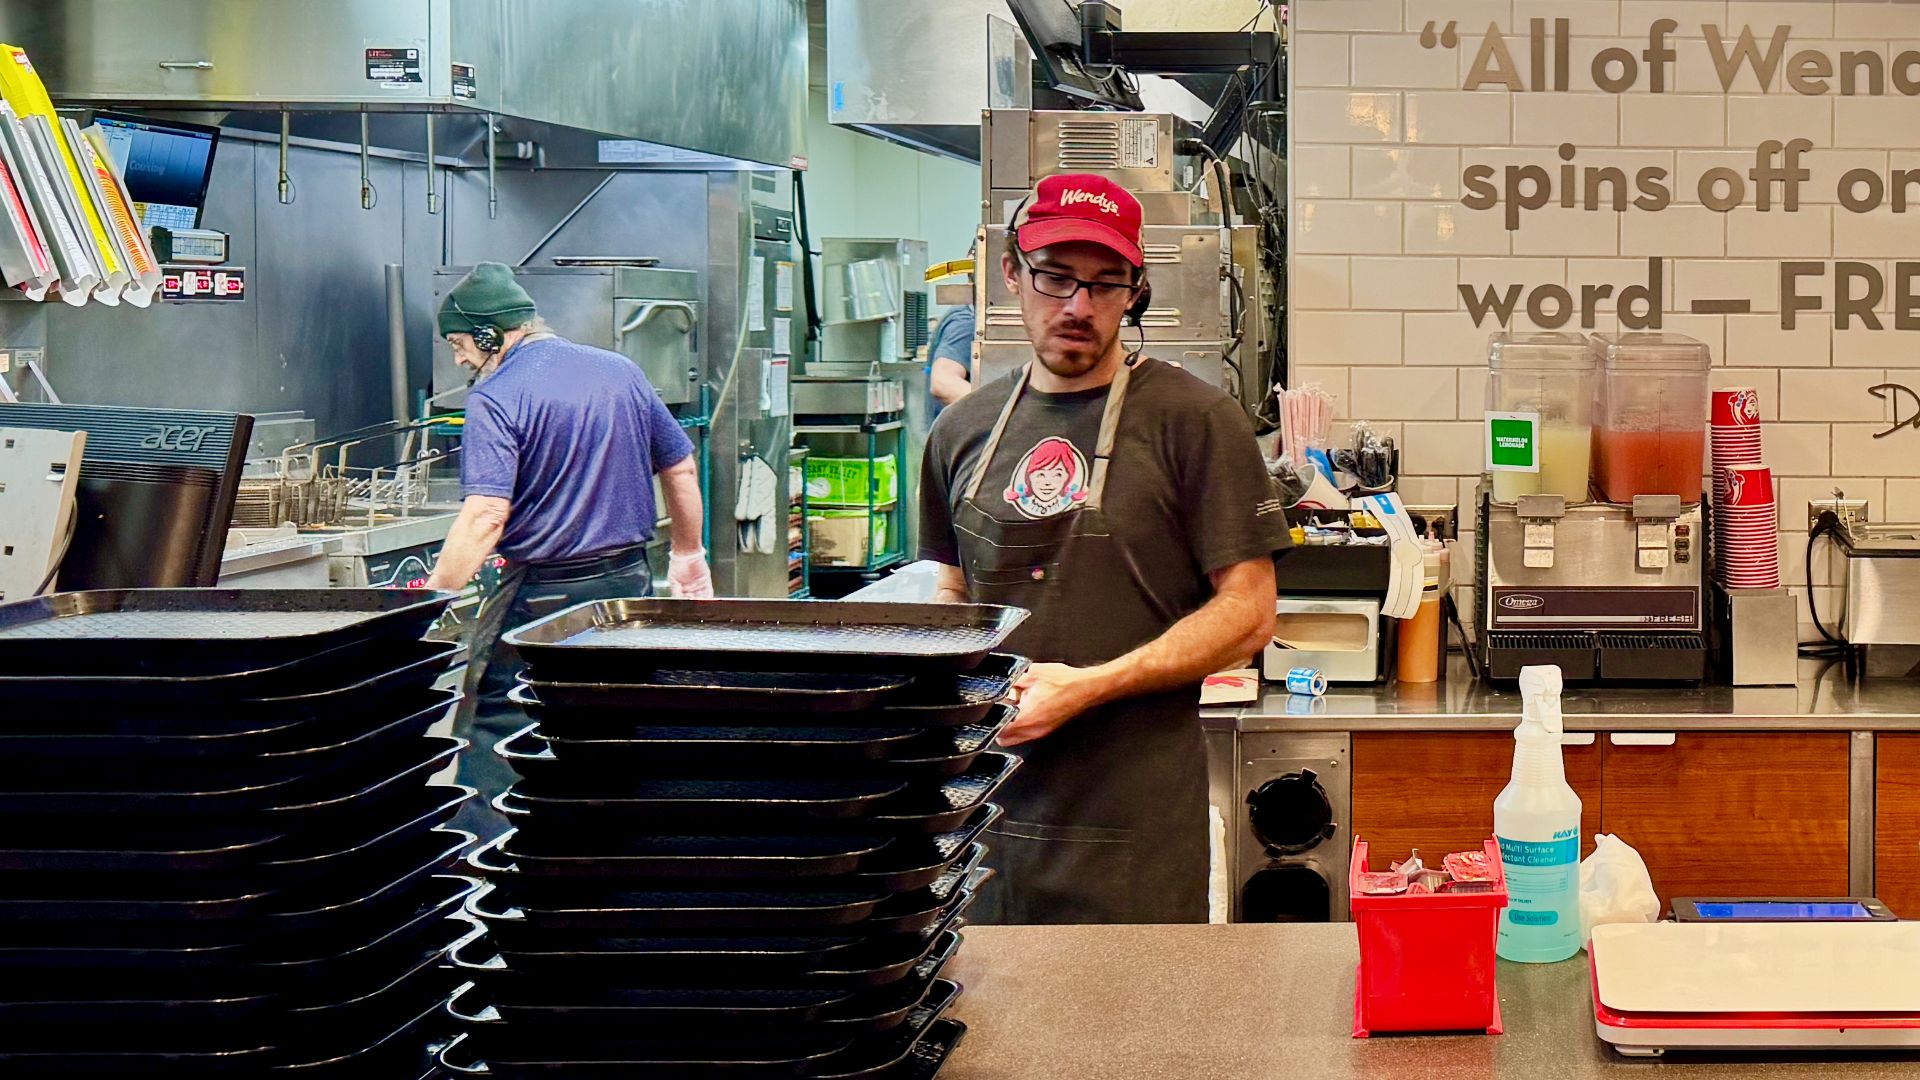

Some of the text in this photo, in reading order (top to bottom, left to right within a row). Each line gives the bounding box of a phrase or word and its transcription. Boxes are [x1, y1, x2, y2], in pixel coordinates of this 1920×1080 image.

[1591, 18, 1679, 94] of
[1460, 142, 1671, 231] spins
[1697, 138, 1814, 213] off
[1060, 188, 1119, 213] Wendy's
[1457, 256, 1663, 330] word
[140, 424, 217, 452] acer
[1505, 596, 1538, 608] Omega
[1506, 843, 1522, 853] Multi
[1525, 845, 1554, 853] Surface
